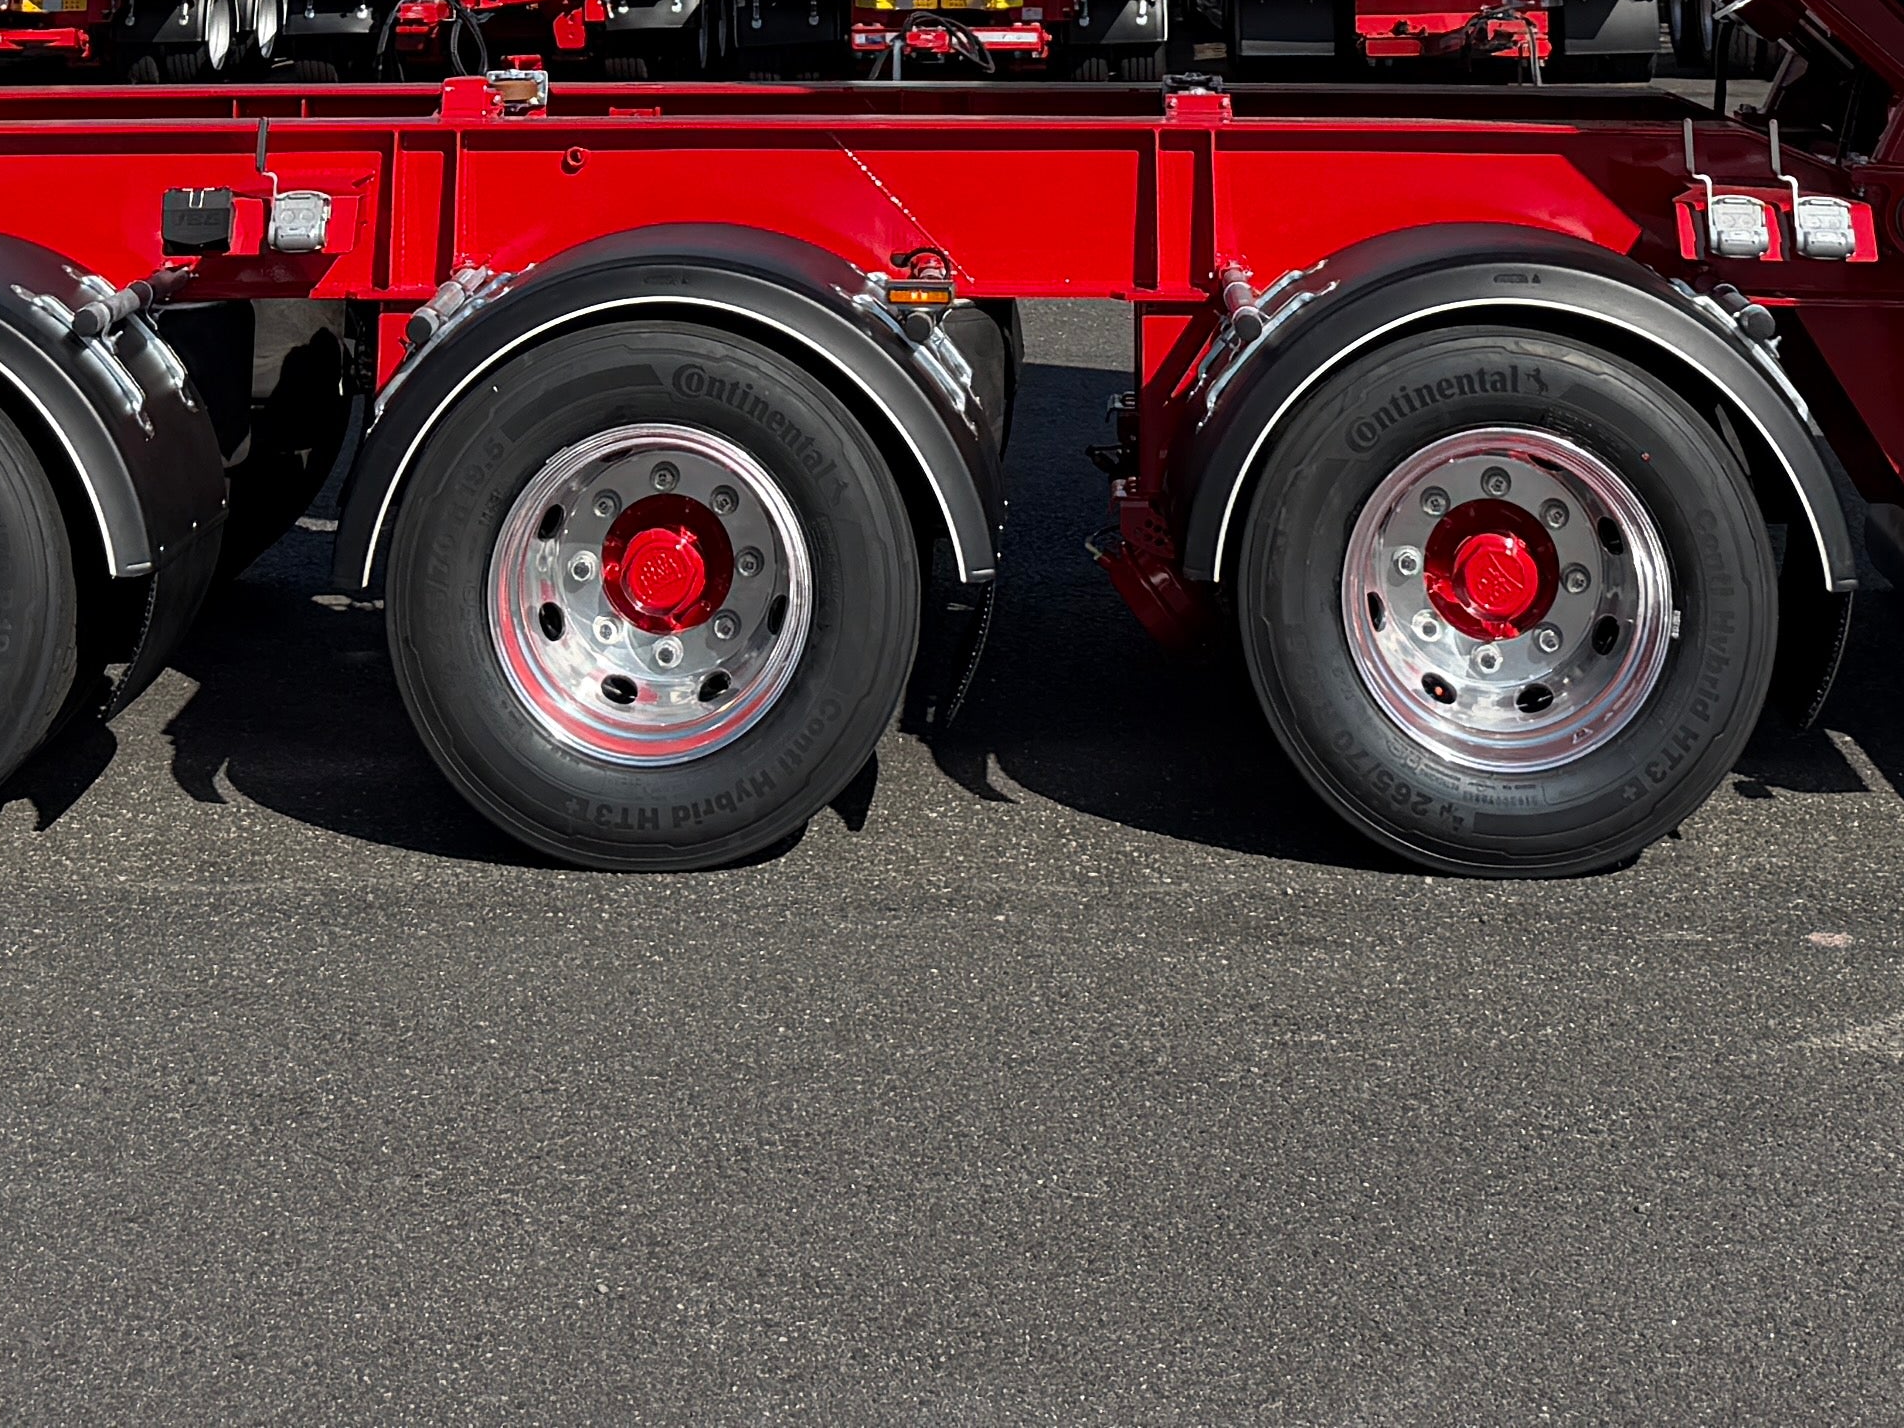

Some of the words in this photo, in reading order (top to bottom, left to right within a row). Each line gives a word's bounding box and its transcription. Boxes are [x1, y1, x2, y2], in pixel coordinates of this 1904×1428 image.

[671, 364, 838, 483] Continental
[1345, 365, 1518, 454] Continental
[1693, 508, 1734, 596] Conti
[1695, 608, 1738, 723] Hybrid
[777, 696, 843, 779] Conti
[1331, 731, 1434, 815] 265/70
[671, 773, 778, 831] Hybrid
